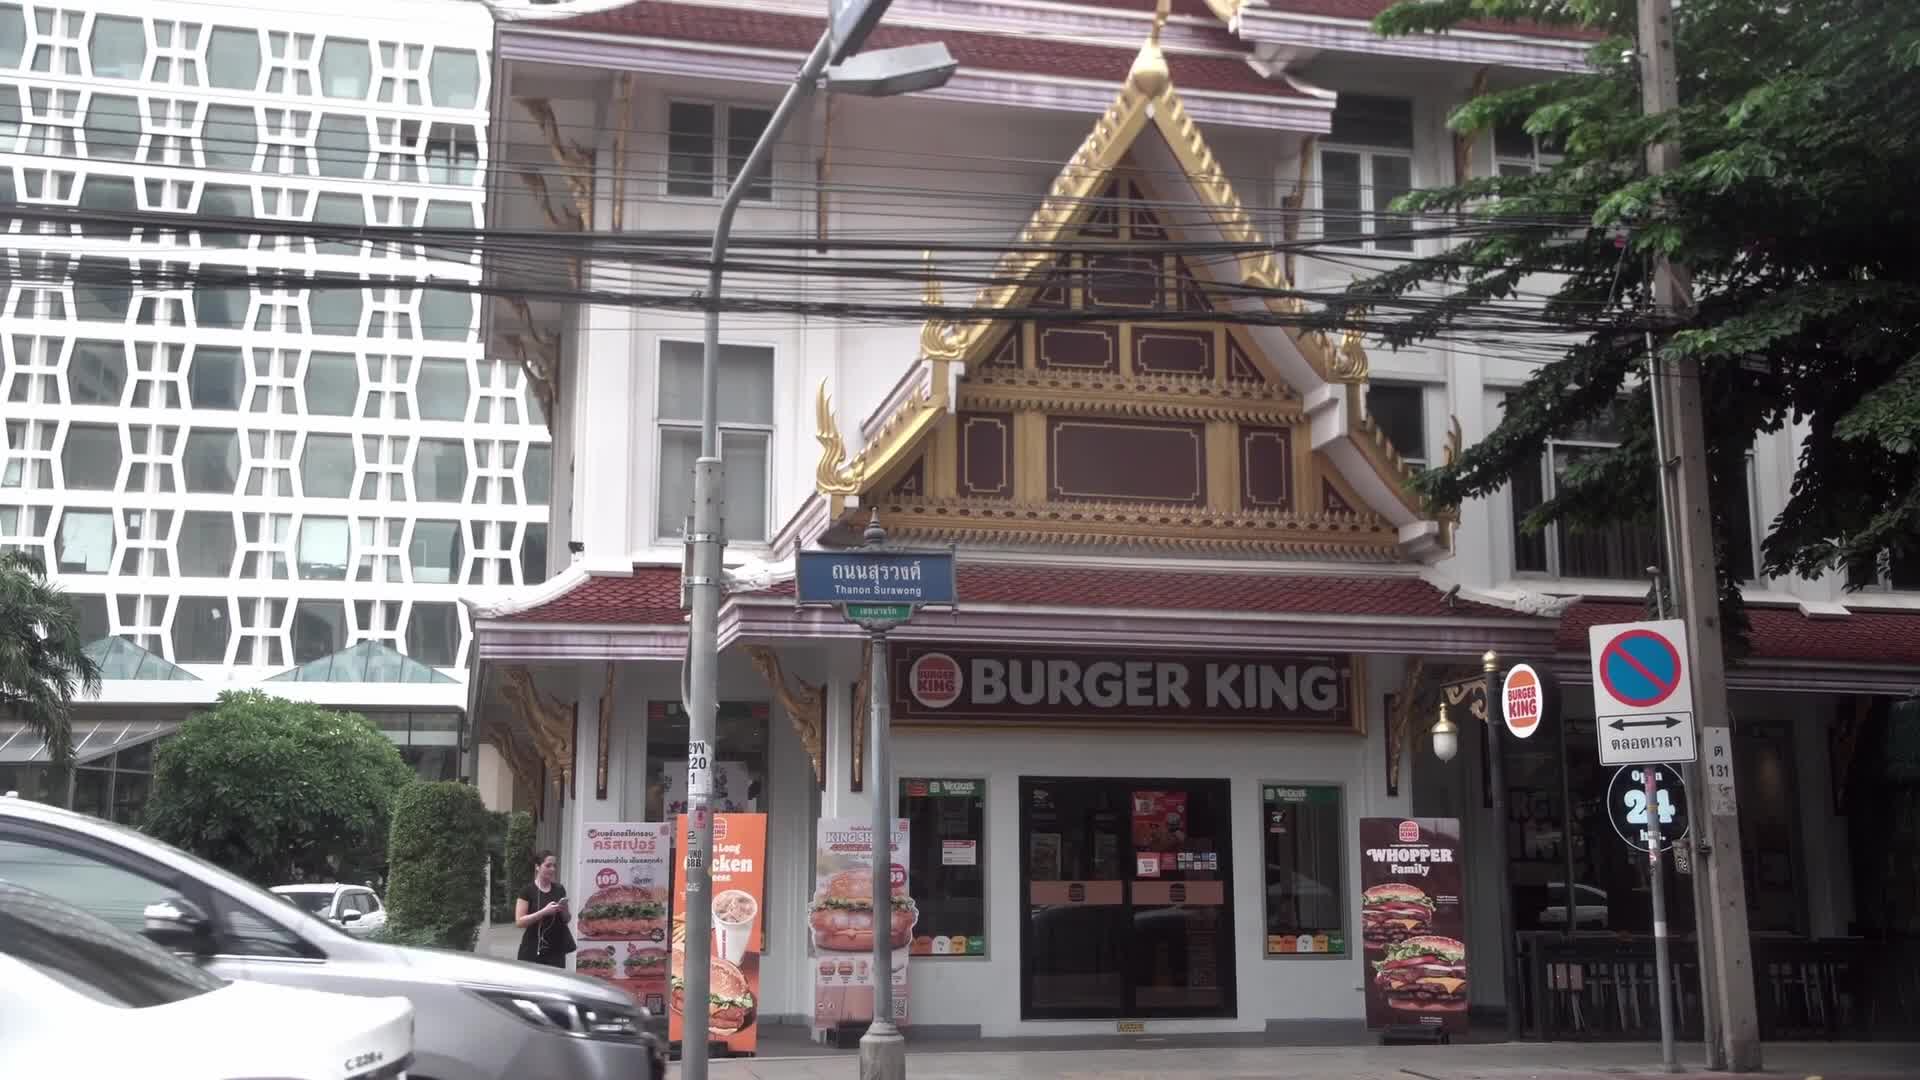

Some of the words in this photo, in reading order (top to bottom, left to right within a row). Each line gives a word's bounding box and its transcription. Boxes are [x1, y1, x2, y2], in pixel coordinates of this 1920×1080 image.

[834, 585, 871, 594] Thanon
[874, 585, 922, 597] Surawong
[917, 670, 955, 680] BURGER
[917, 679, 955, 693] KING
[971, 658, 1191, 708] BURGER
[1205, 663, 1339, 711] KING
[1507, 686, 1537, 701] BURGER
[1508, 699, 1537, 718] KING
[1611, 736, 1682, 750] ตลอดเวลา
[1709, 765, 1729, 777] 131
[1624, 789, 1676, 823] 24
[1366, 848, 1453, 862] WHOPPER
[1391, 863, 1430, 876] Family
